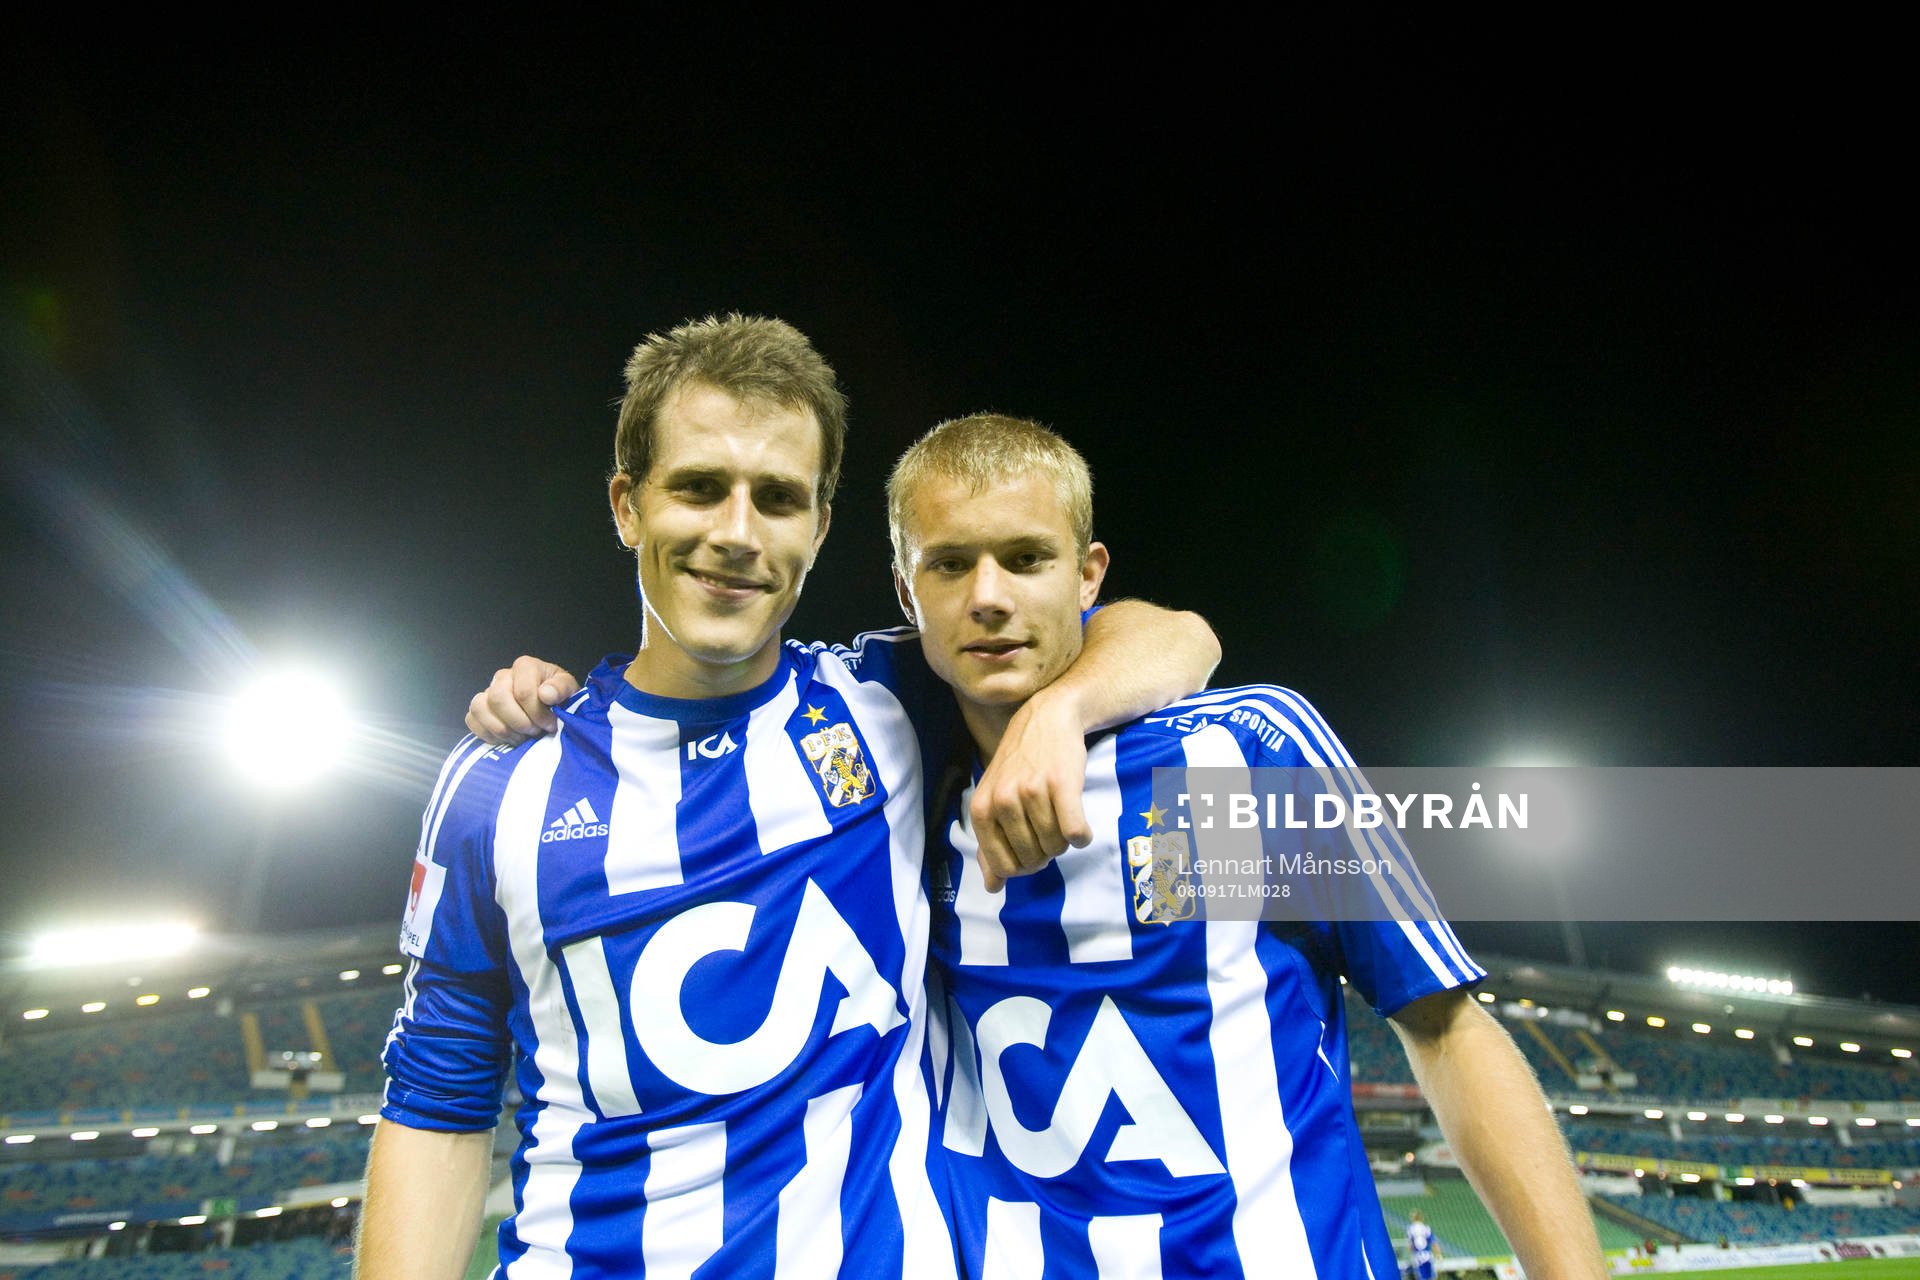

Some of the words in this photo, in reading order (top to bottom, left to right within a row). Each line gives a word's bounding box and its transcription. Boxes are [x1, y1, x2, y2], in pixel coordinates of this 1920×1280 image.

[687, 731, 739, 761] ICA
[1229, 709, 1286, 752] SPORTIA
[541, 822, 609, 843] adidas
[561, 877, 909, 1118] ICA
[942, 994, 1228, 1178] ICA
